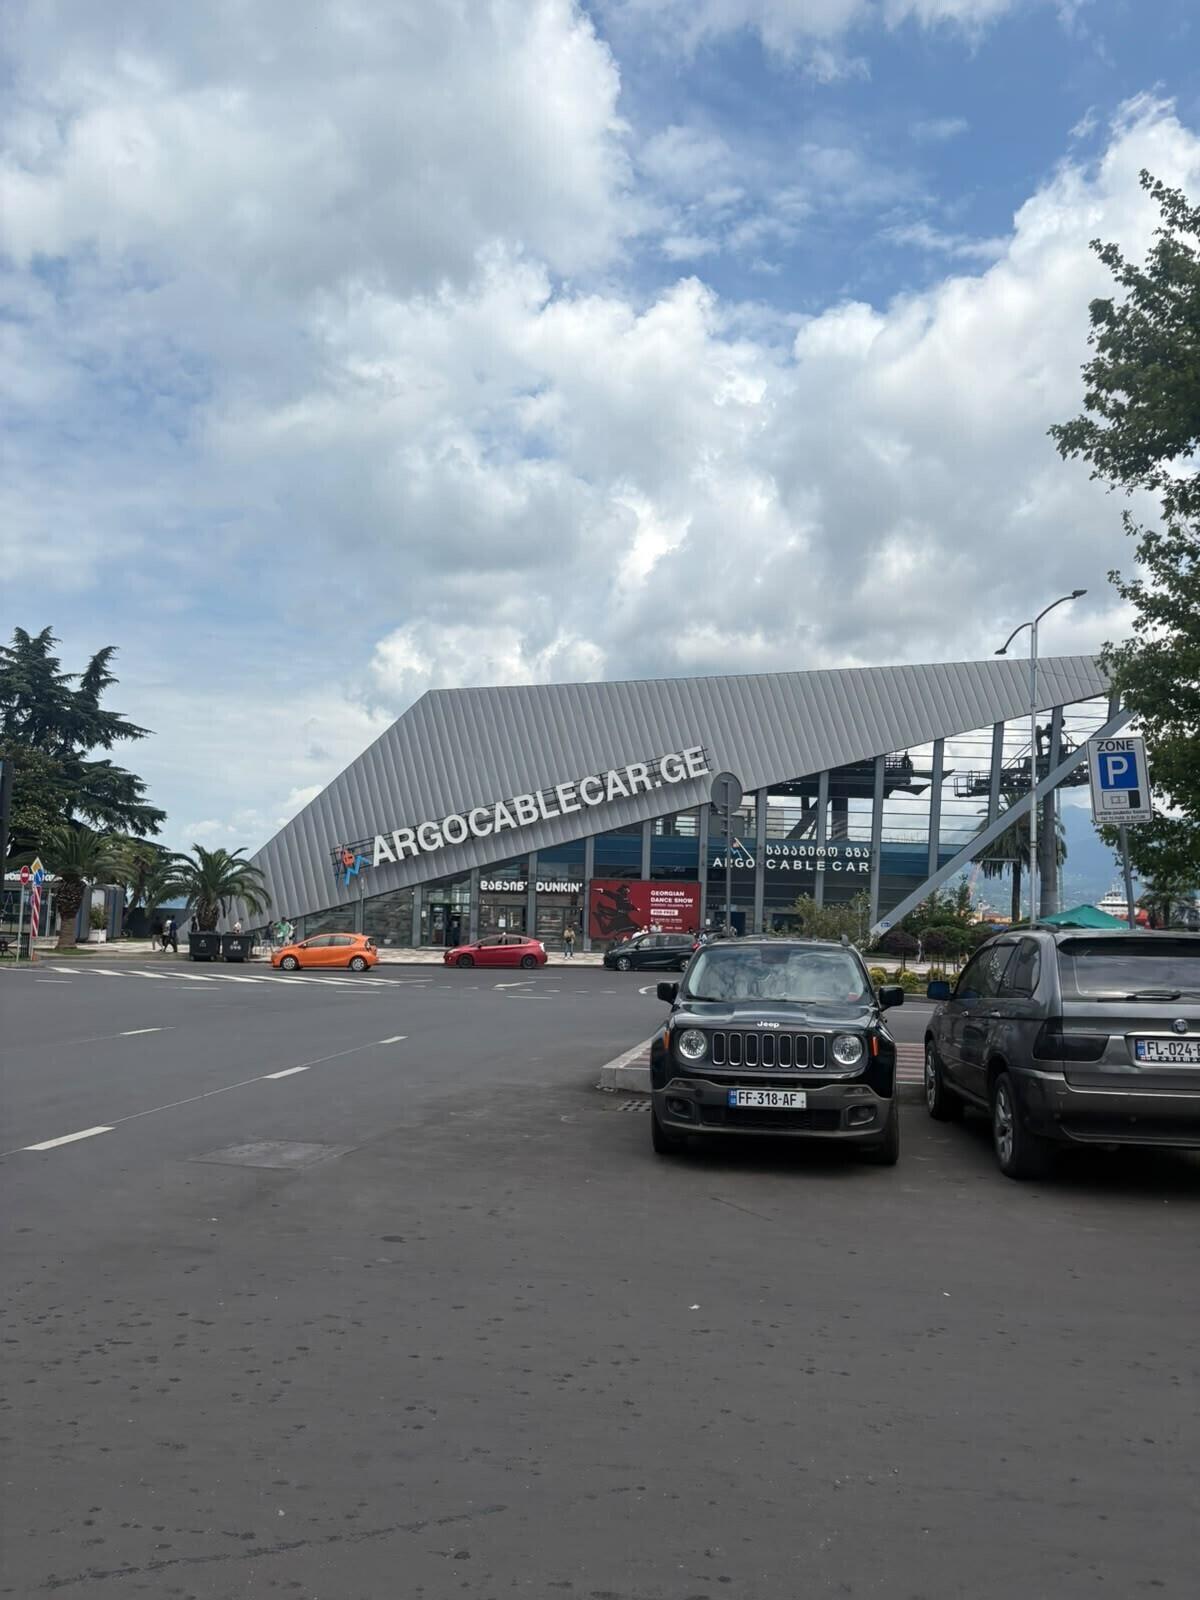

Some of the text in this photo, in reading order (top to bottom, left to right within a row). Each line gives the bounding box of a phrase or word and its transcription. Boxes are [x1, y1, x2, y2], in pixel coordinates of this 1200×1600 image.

[1097, 740, 1135, 752] ZONE
[1107, 756, 1129, 786] P
[373, 745, 710, 867] ARGOCABLECAR.GE
[766, 859, 826, 871] CABLE
[832, 861, 870, 872] CAR
[536, 881, 583, 893] DUNKIN'
[738, 1091, 797, 1106] FF-318-AF
